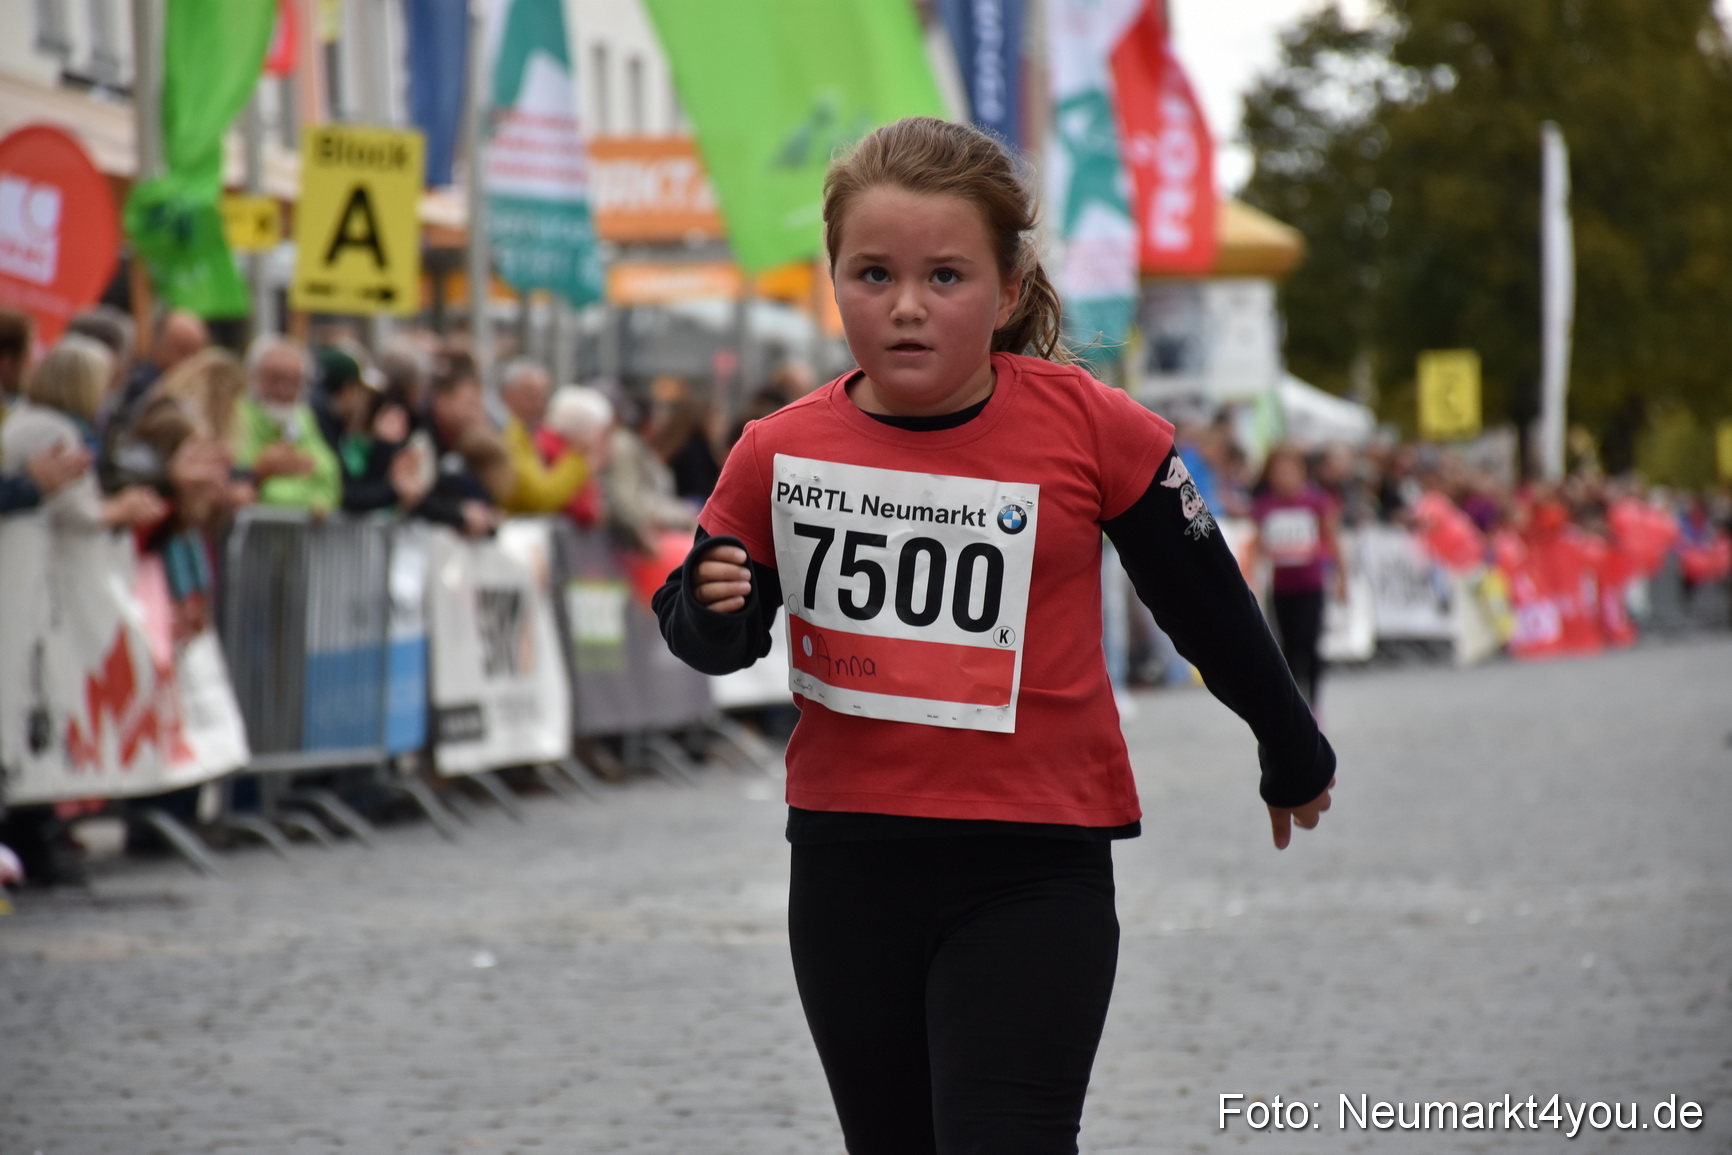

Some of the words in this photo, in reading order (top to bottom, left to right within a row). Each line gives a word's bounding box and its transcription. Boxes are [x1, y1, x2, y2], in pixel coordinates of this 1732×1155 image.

[324, 183, 390, 272] A
[776, 481, 854, 514] PARTL
[860, 494, 987, 528] Neumarkt
[793, 521, 1005, 633] 7500
[816, 633, 877, 678] Anna
[999, 629, 1009, 644] K
